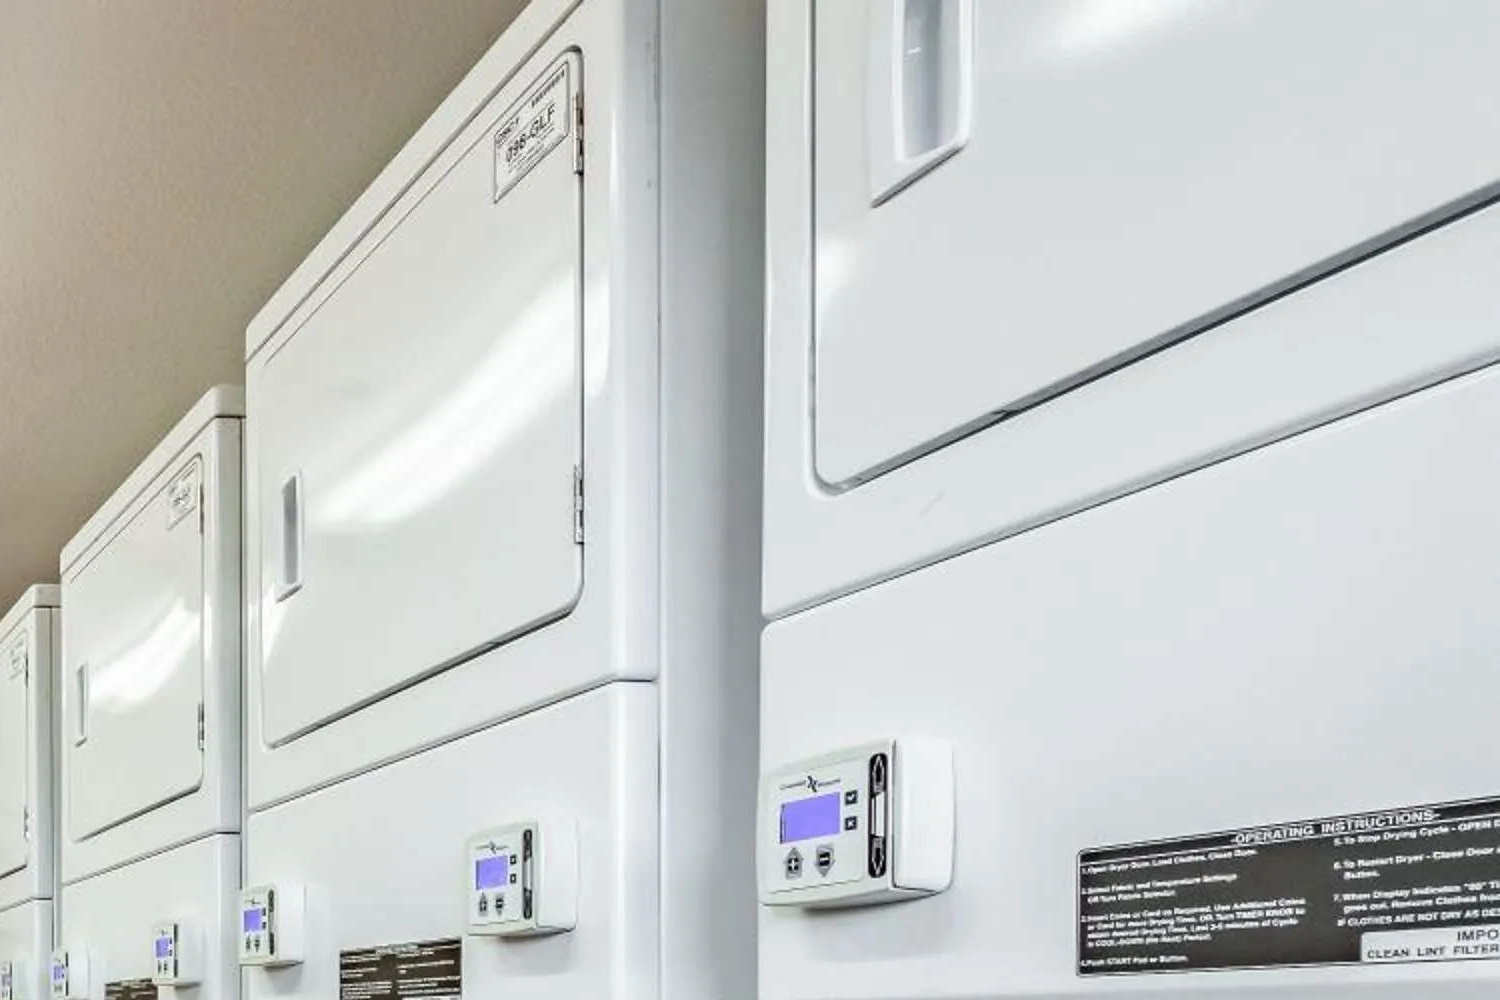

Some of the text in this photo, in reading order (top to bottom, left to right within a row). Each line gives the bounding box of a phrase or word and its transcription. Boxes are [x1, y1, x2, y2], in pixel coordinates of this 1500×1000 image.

[1417, 912, 1438, 921] NOT
[1367, 943, 1500, 959] CLEAN LINT FILTER
